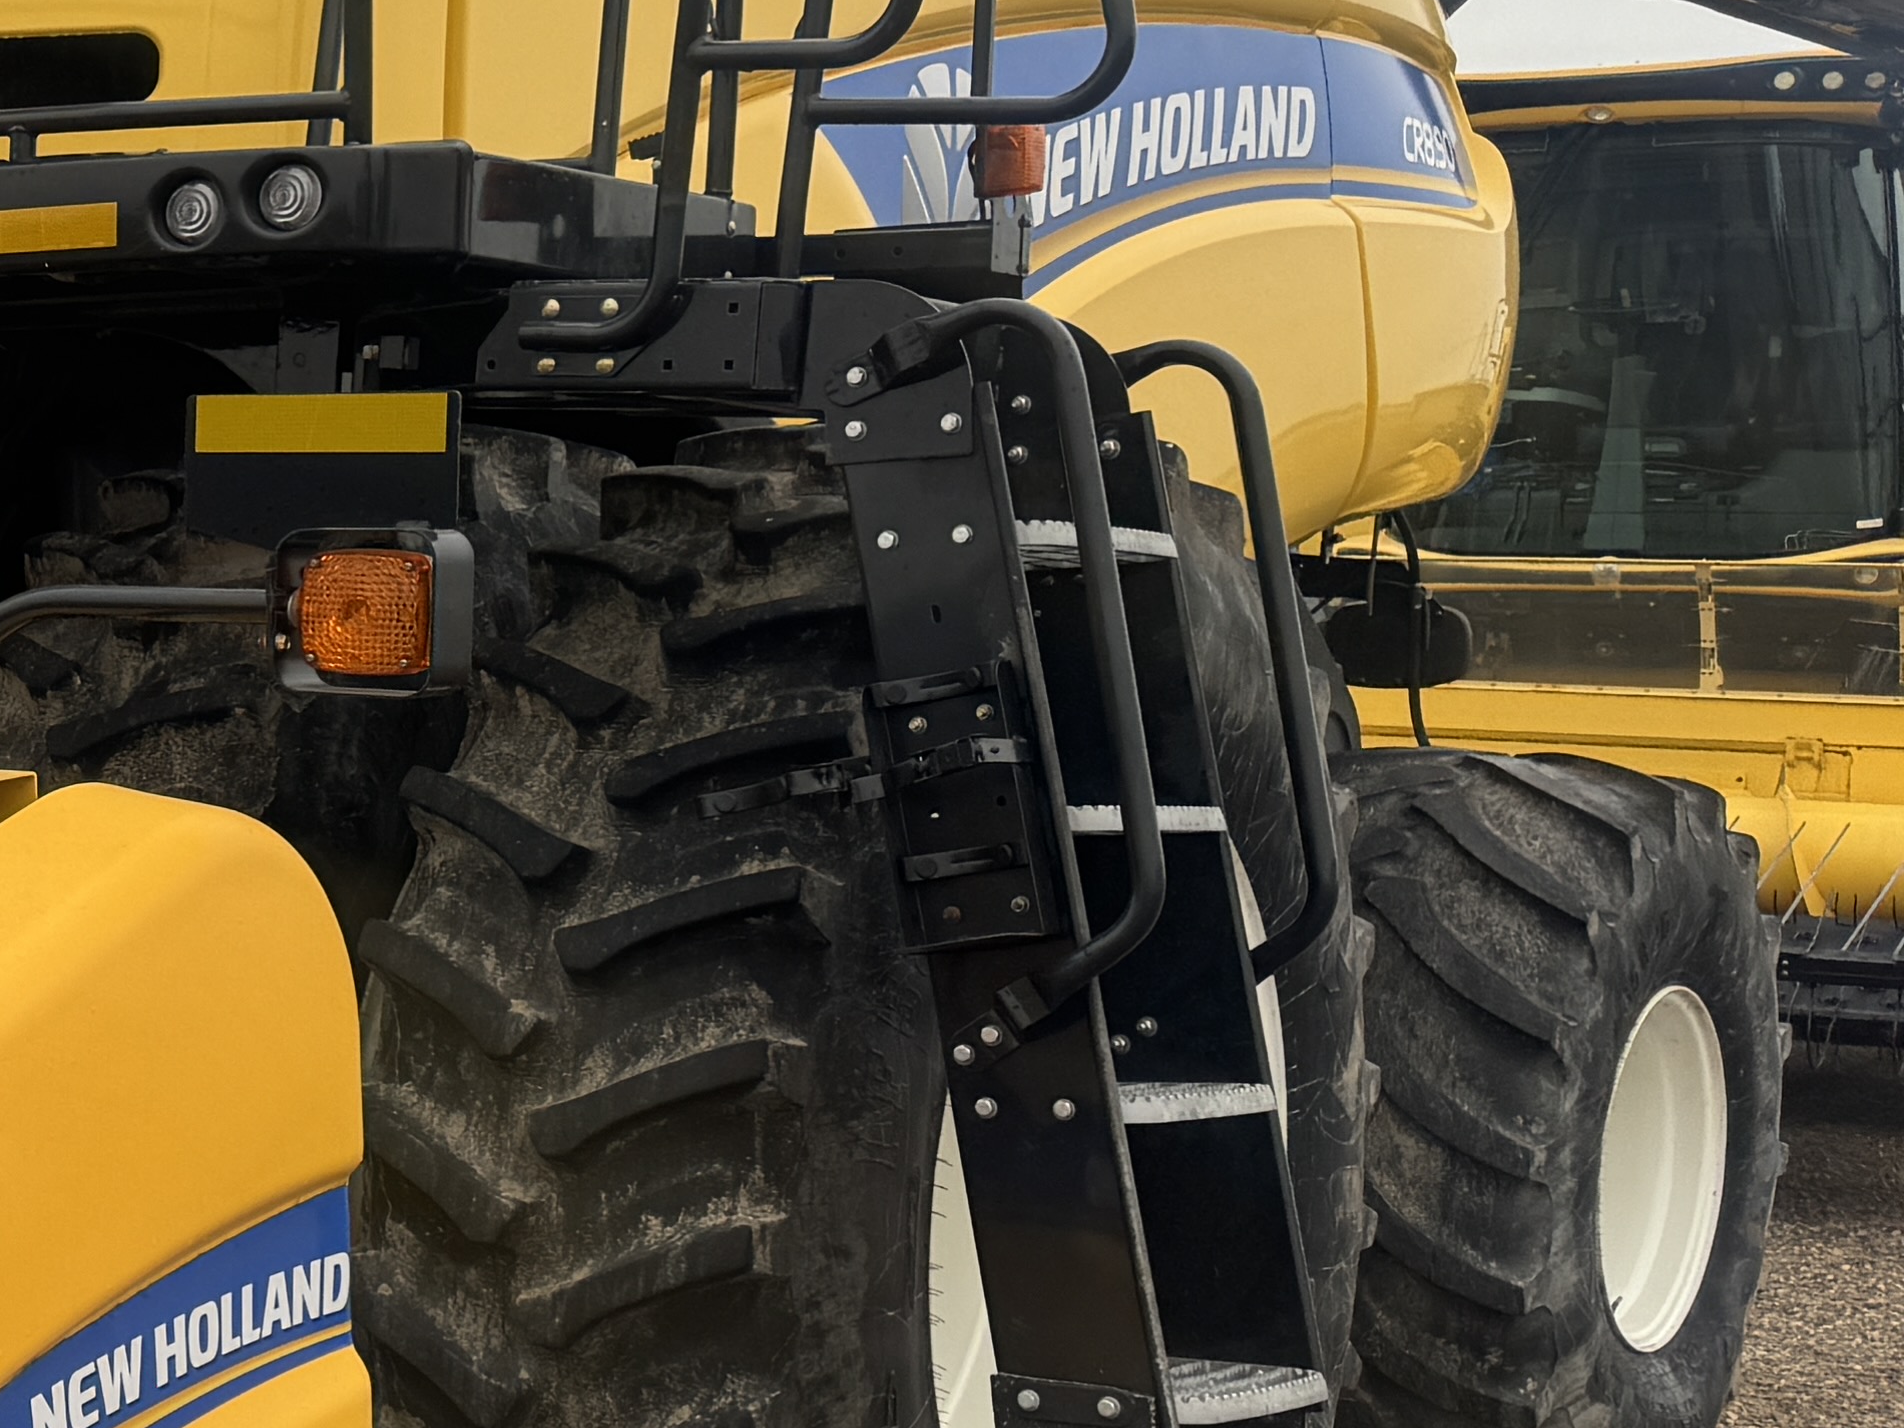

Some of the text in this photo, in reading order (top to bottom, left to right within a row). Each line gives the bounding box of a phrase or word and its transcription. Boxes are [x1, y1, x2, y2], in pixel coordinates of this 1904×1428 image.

[1026, 85, 1316, 228] EW HOLLAND
[154, 1252, 350, 1388] HOLLAND
